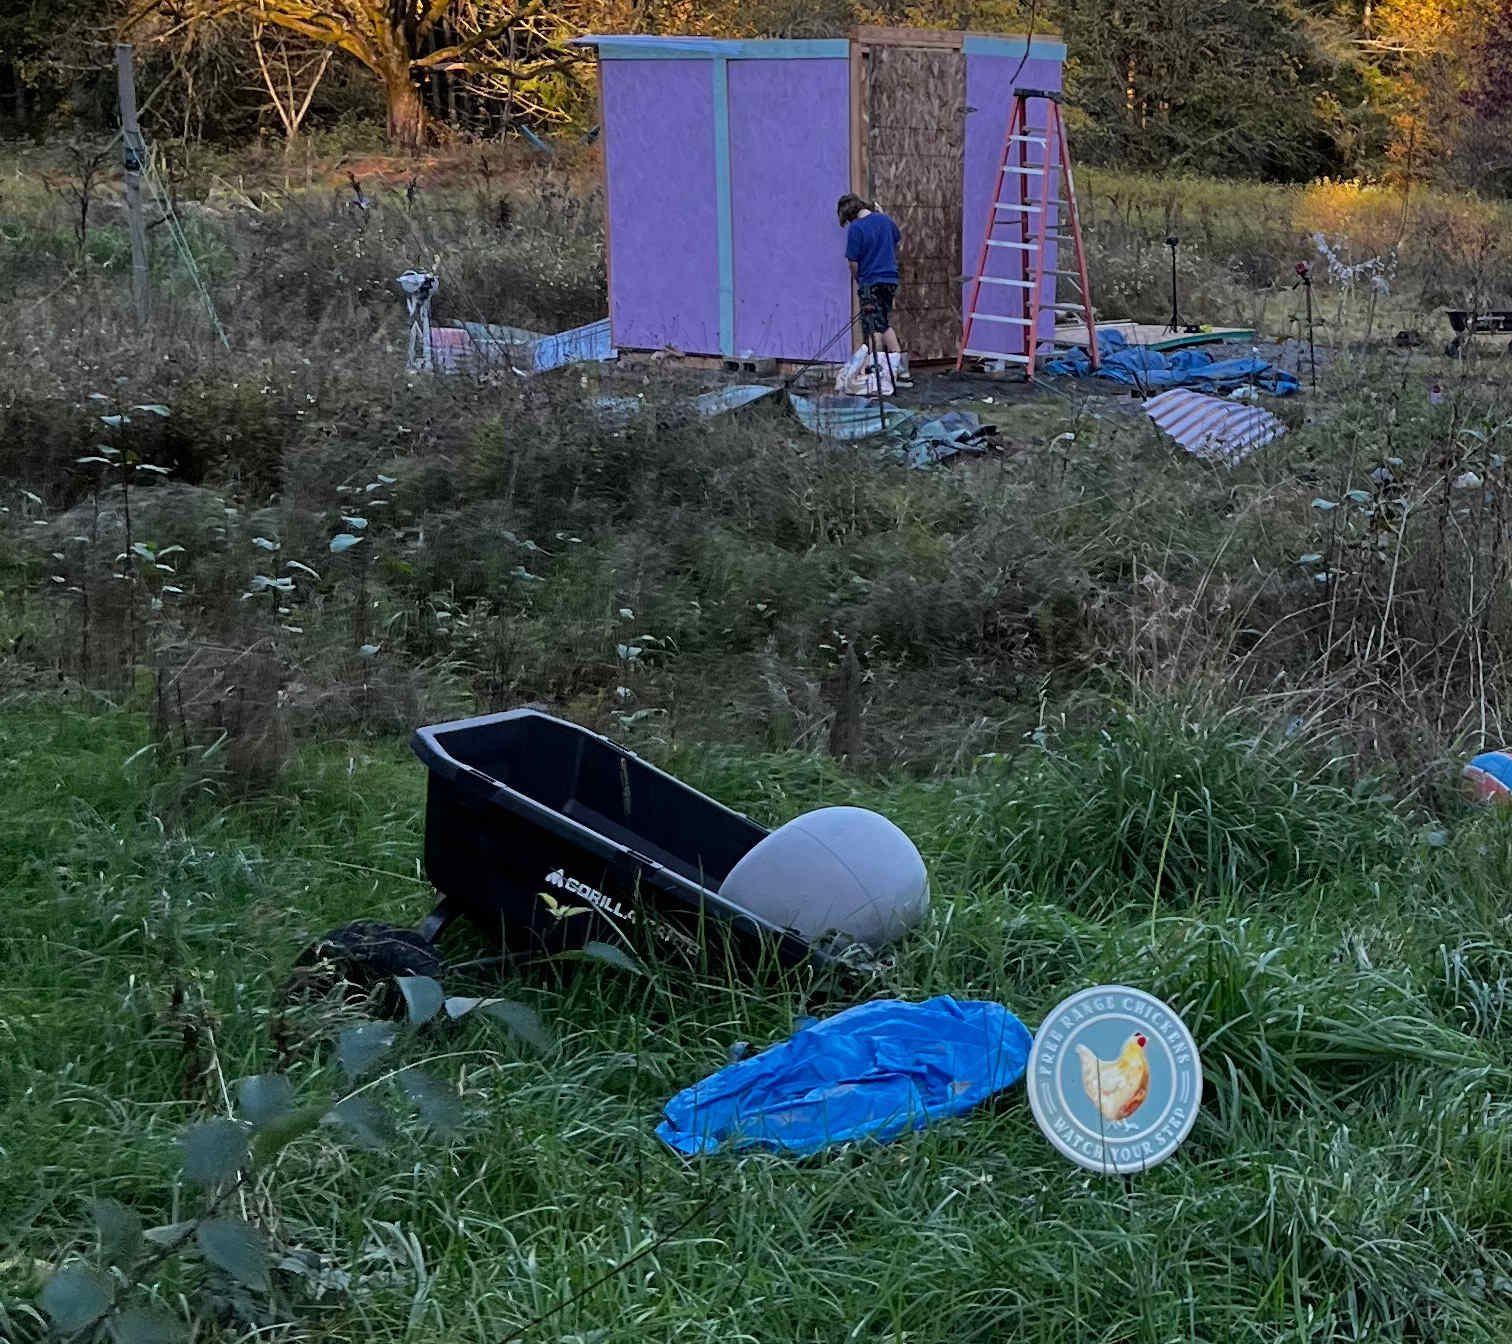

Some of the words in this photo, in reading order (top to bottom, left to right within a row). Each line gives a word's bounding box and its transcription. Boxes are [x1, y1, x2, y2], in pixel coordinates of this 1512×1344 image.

[1039, 1030, 1064, 1075] FREE
[1059, 996, 1116, 1029] RANGE
[1122, 997, 1191, 1064] CHICKENS
[1053, 1115, 1104, 1159] WATCH
[1111, 1141, 1154, 1162] YOUR
[1155, 1106, 1186, 1146] STEP
